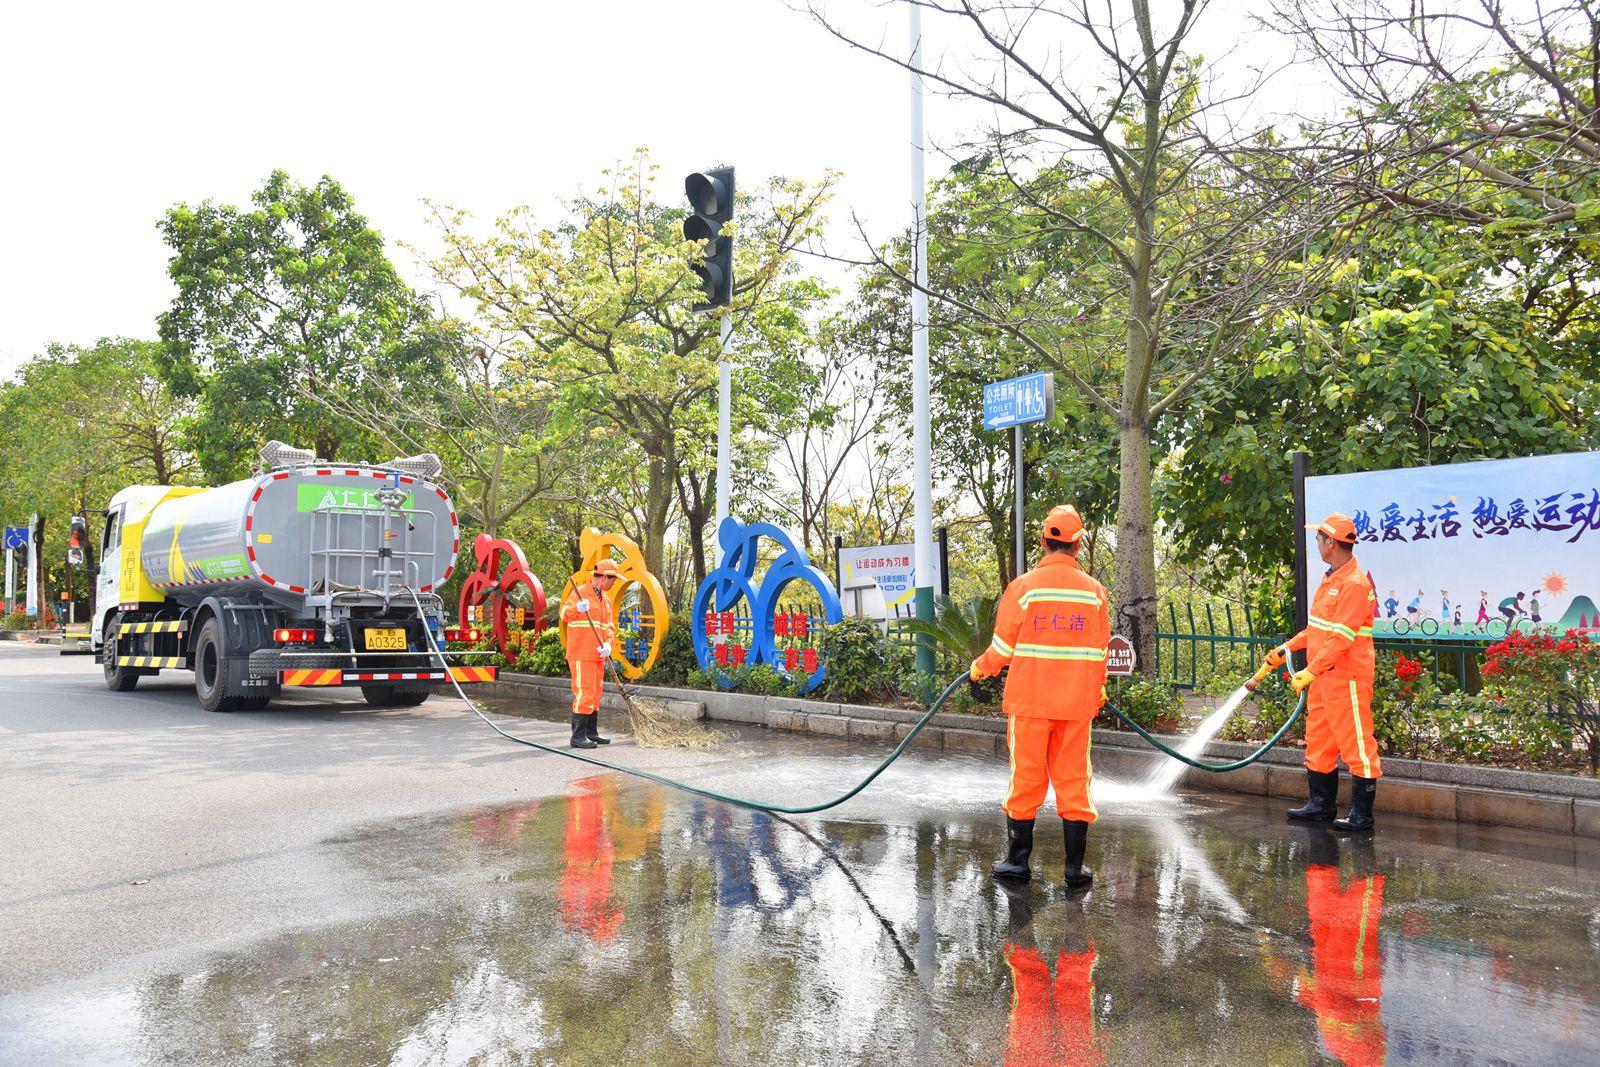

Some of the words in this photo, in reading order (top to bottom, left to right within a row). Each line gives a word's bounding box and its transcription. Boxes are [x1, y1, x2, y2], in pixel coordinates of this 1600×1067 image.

[987, 382, 1015, 404] 公共厕所
[988, 402, 1012, 413] TOILET
[1353, 502, 1462, 543] 热爱生活
[1471, 488, 1600, 544] 热爱运动
[856, 556, 910, 569] 让运动成为习惯
[705, 612, 735, 635] 爱国
[773, 610, 807, 638] 诚信
[1034, 614, 1085, 632] 仁仁洁
[368, 636, 404, 648] A0325
[714, 643, 746, 667] 敬业
[784, 646, 818, 674] 友善
